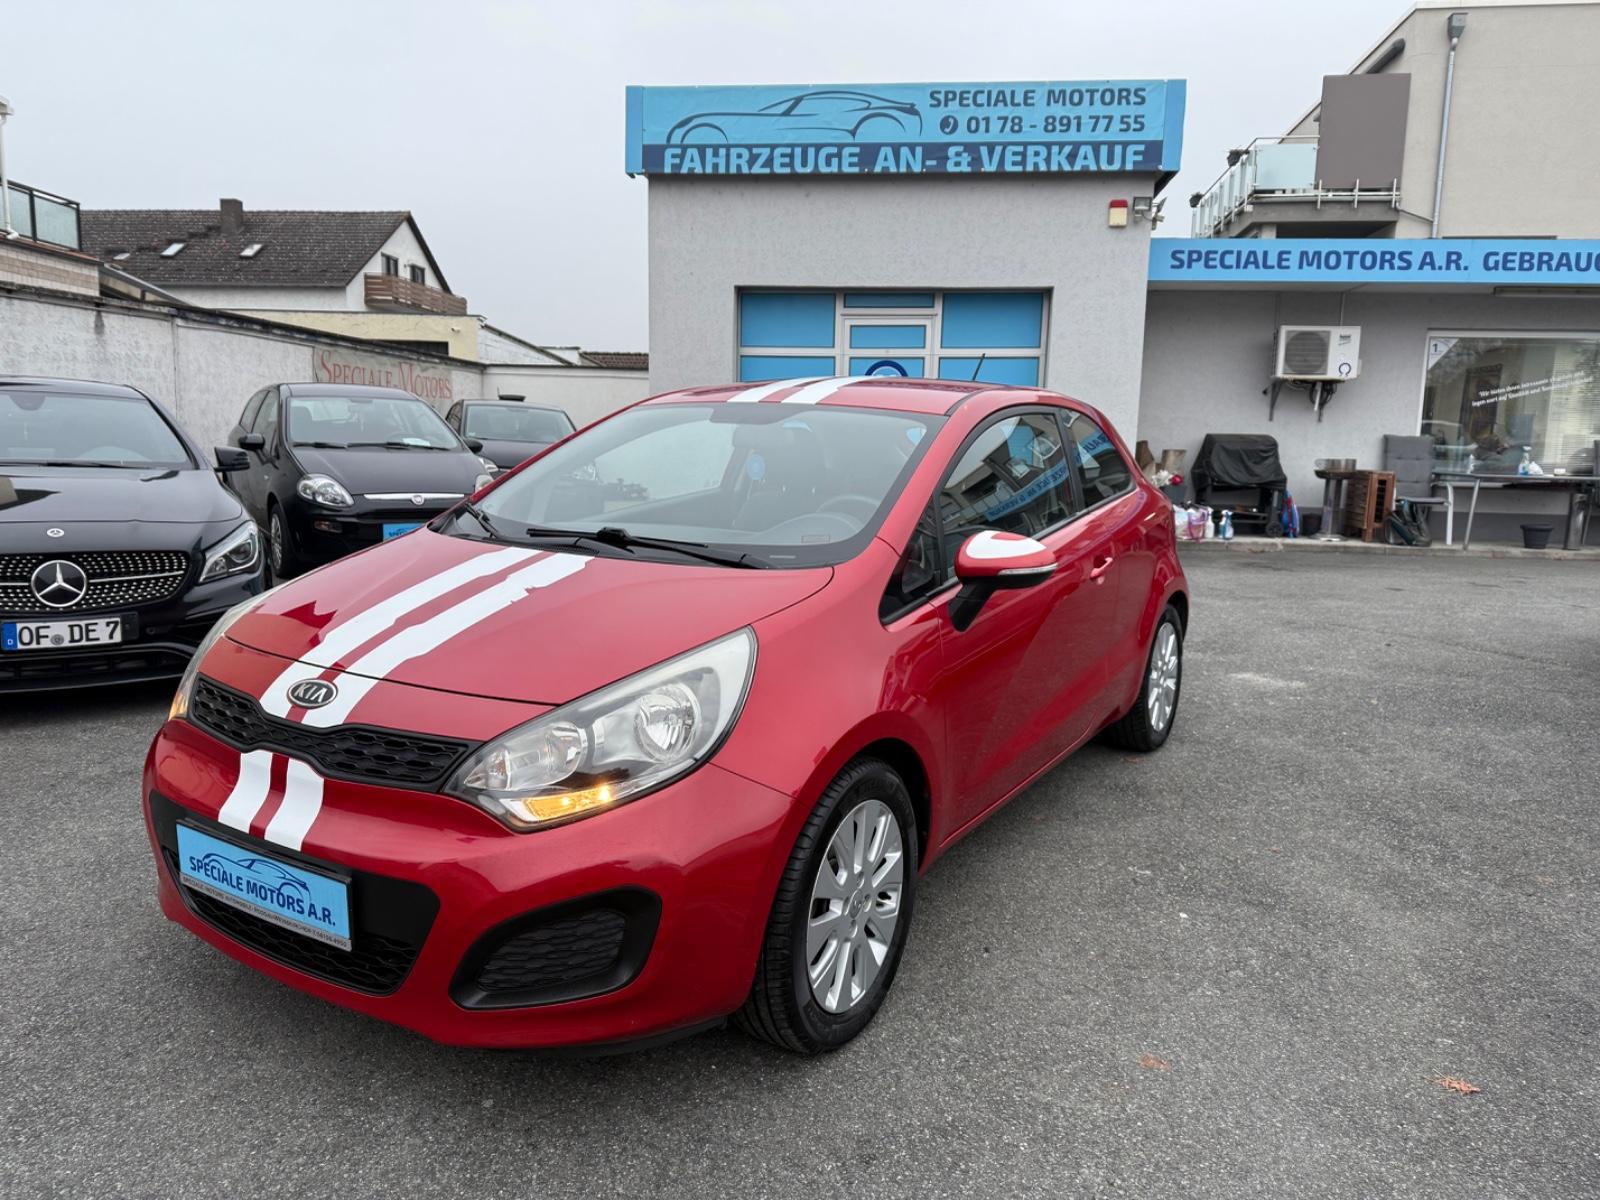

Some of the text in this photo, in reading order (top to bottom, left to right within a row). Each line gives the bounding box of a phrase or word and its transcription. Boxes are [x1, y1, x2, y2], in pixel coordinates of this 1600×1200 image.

[929, 87, 1147, 108] SPECIALE MOTORS
[663, 144, 1146, 174] FAHRZEUGE AN- & VERKAUF
[1170, 249, 1292, 271] SPECIALE
[1298, 249, 1413, 271] MOTORS
[1417, 250, 1470, 272] A.R.
[18, 625, 51, 646] OF
[67, 622, 100, 644] DE
[105, 620, 120, 640] 7
[293, 683, 328, 703] KIA
[189, 856, 244, 892] SPECIALE
[246, 879, 305, 915] MOTORS
[307, 902, 336, 926] A.R.
